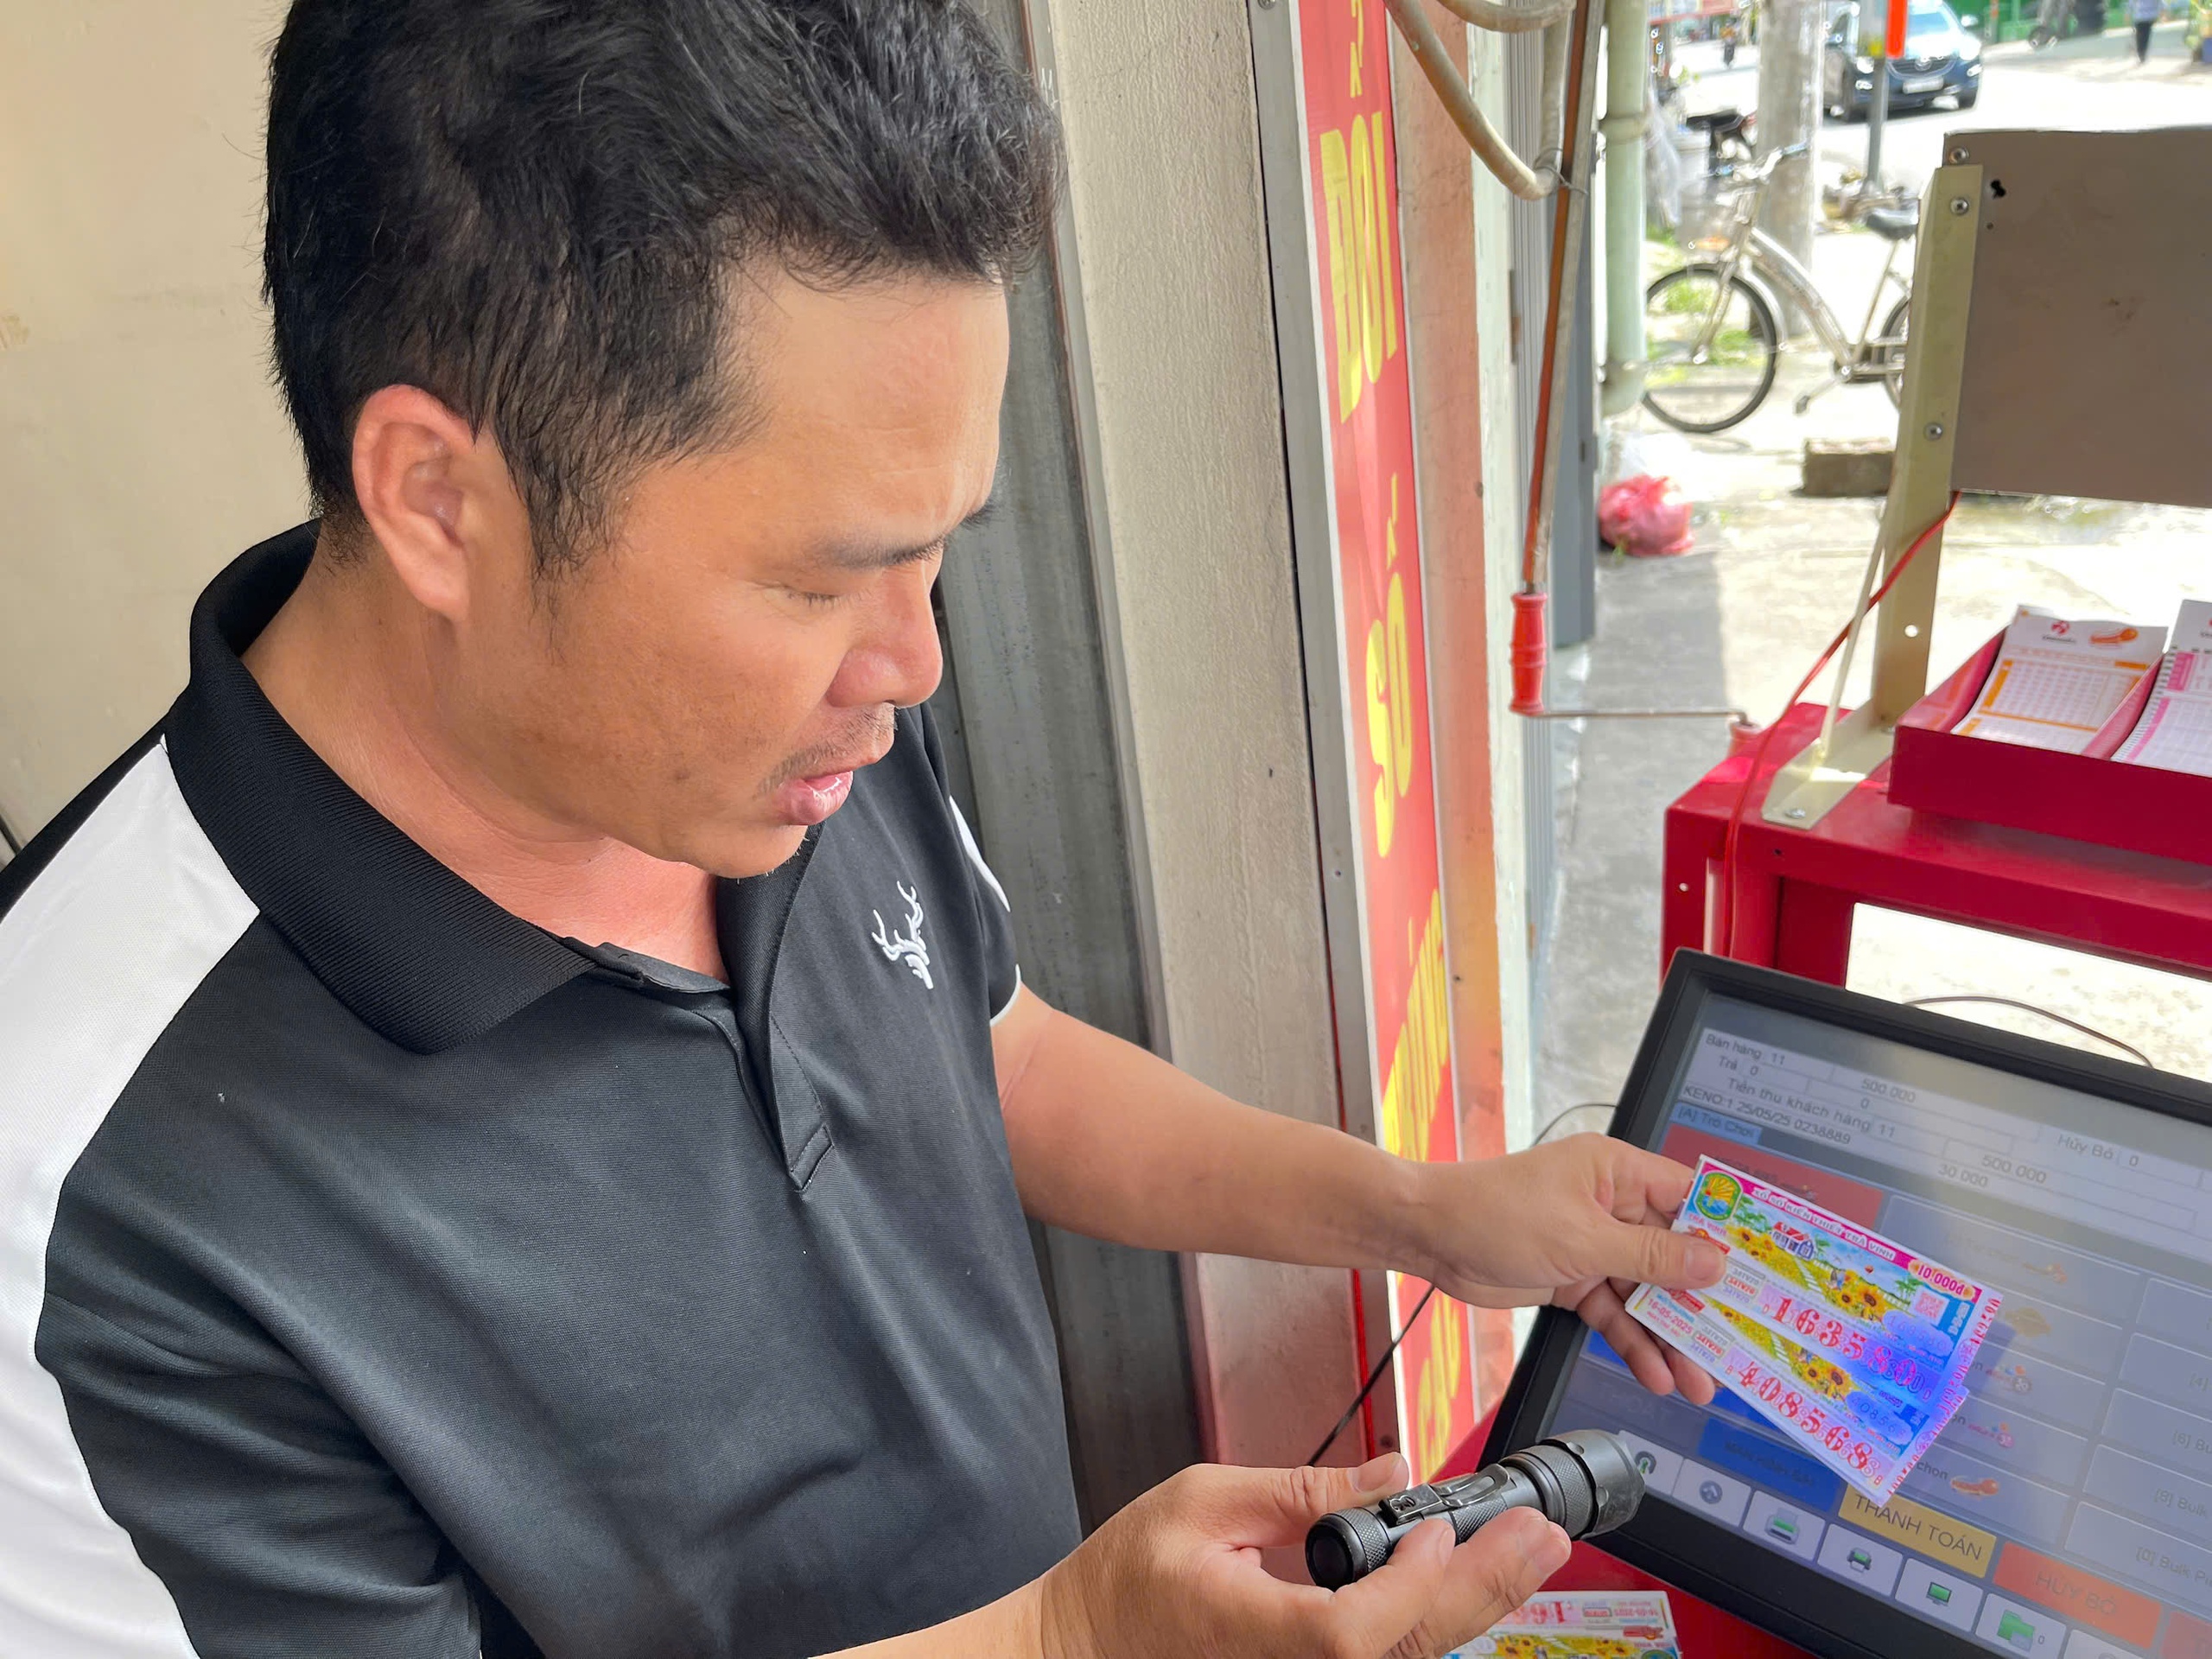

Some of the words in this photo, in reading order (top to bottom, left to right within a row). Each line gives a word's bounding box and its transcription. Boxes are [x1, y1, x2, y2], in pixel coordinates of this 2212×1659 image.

[1366, 473, 1412, 857] SỐ
[1760, 1087, 1782, 1103] thu
[1736, 1101, 1791, 1126] 25/05/25
[1869, 1241, 1896, 1261] VINH
[1647, 1298, 1694, 1335] 16-05-2025
[1772, 1296, 1918, 1387] 163580
[1738, 1361, 1873, 1470] 408568
[1929, 1524, 1982, 1560] TOÁN
